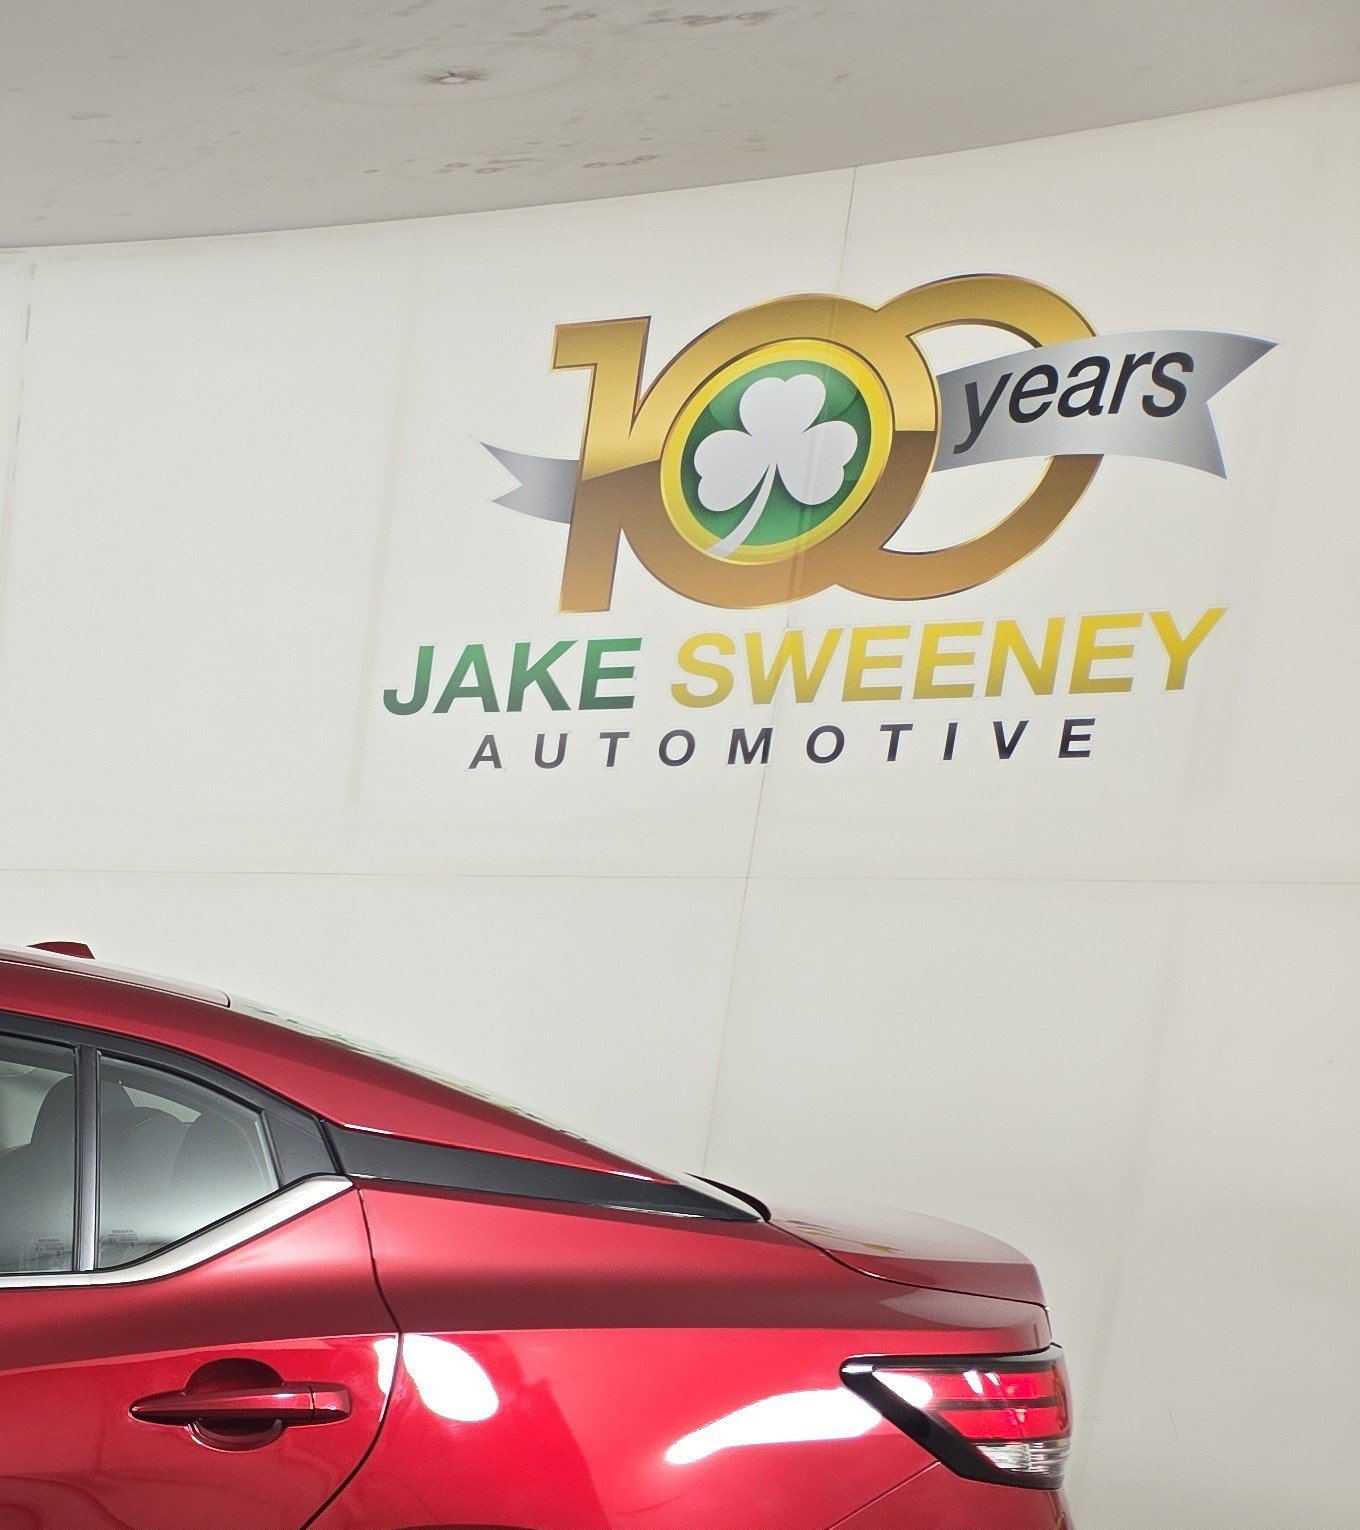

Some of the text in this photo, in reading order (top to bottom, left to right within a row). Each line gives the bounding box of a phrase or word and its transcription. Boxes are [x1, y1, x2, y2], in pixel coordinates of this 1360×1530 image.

[551, 273, 1195, 613] 100 years
[382, 606, 1228, 718] JAKE SWEENEY
[468, 716, 1097, 771] AUTOMOTIVE
